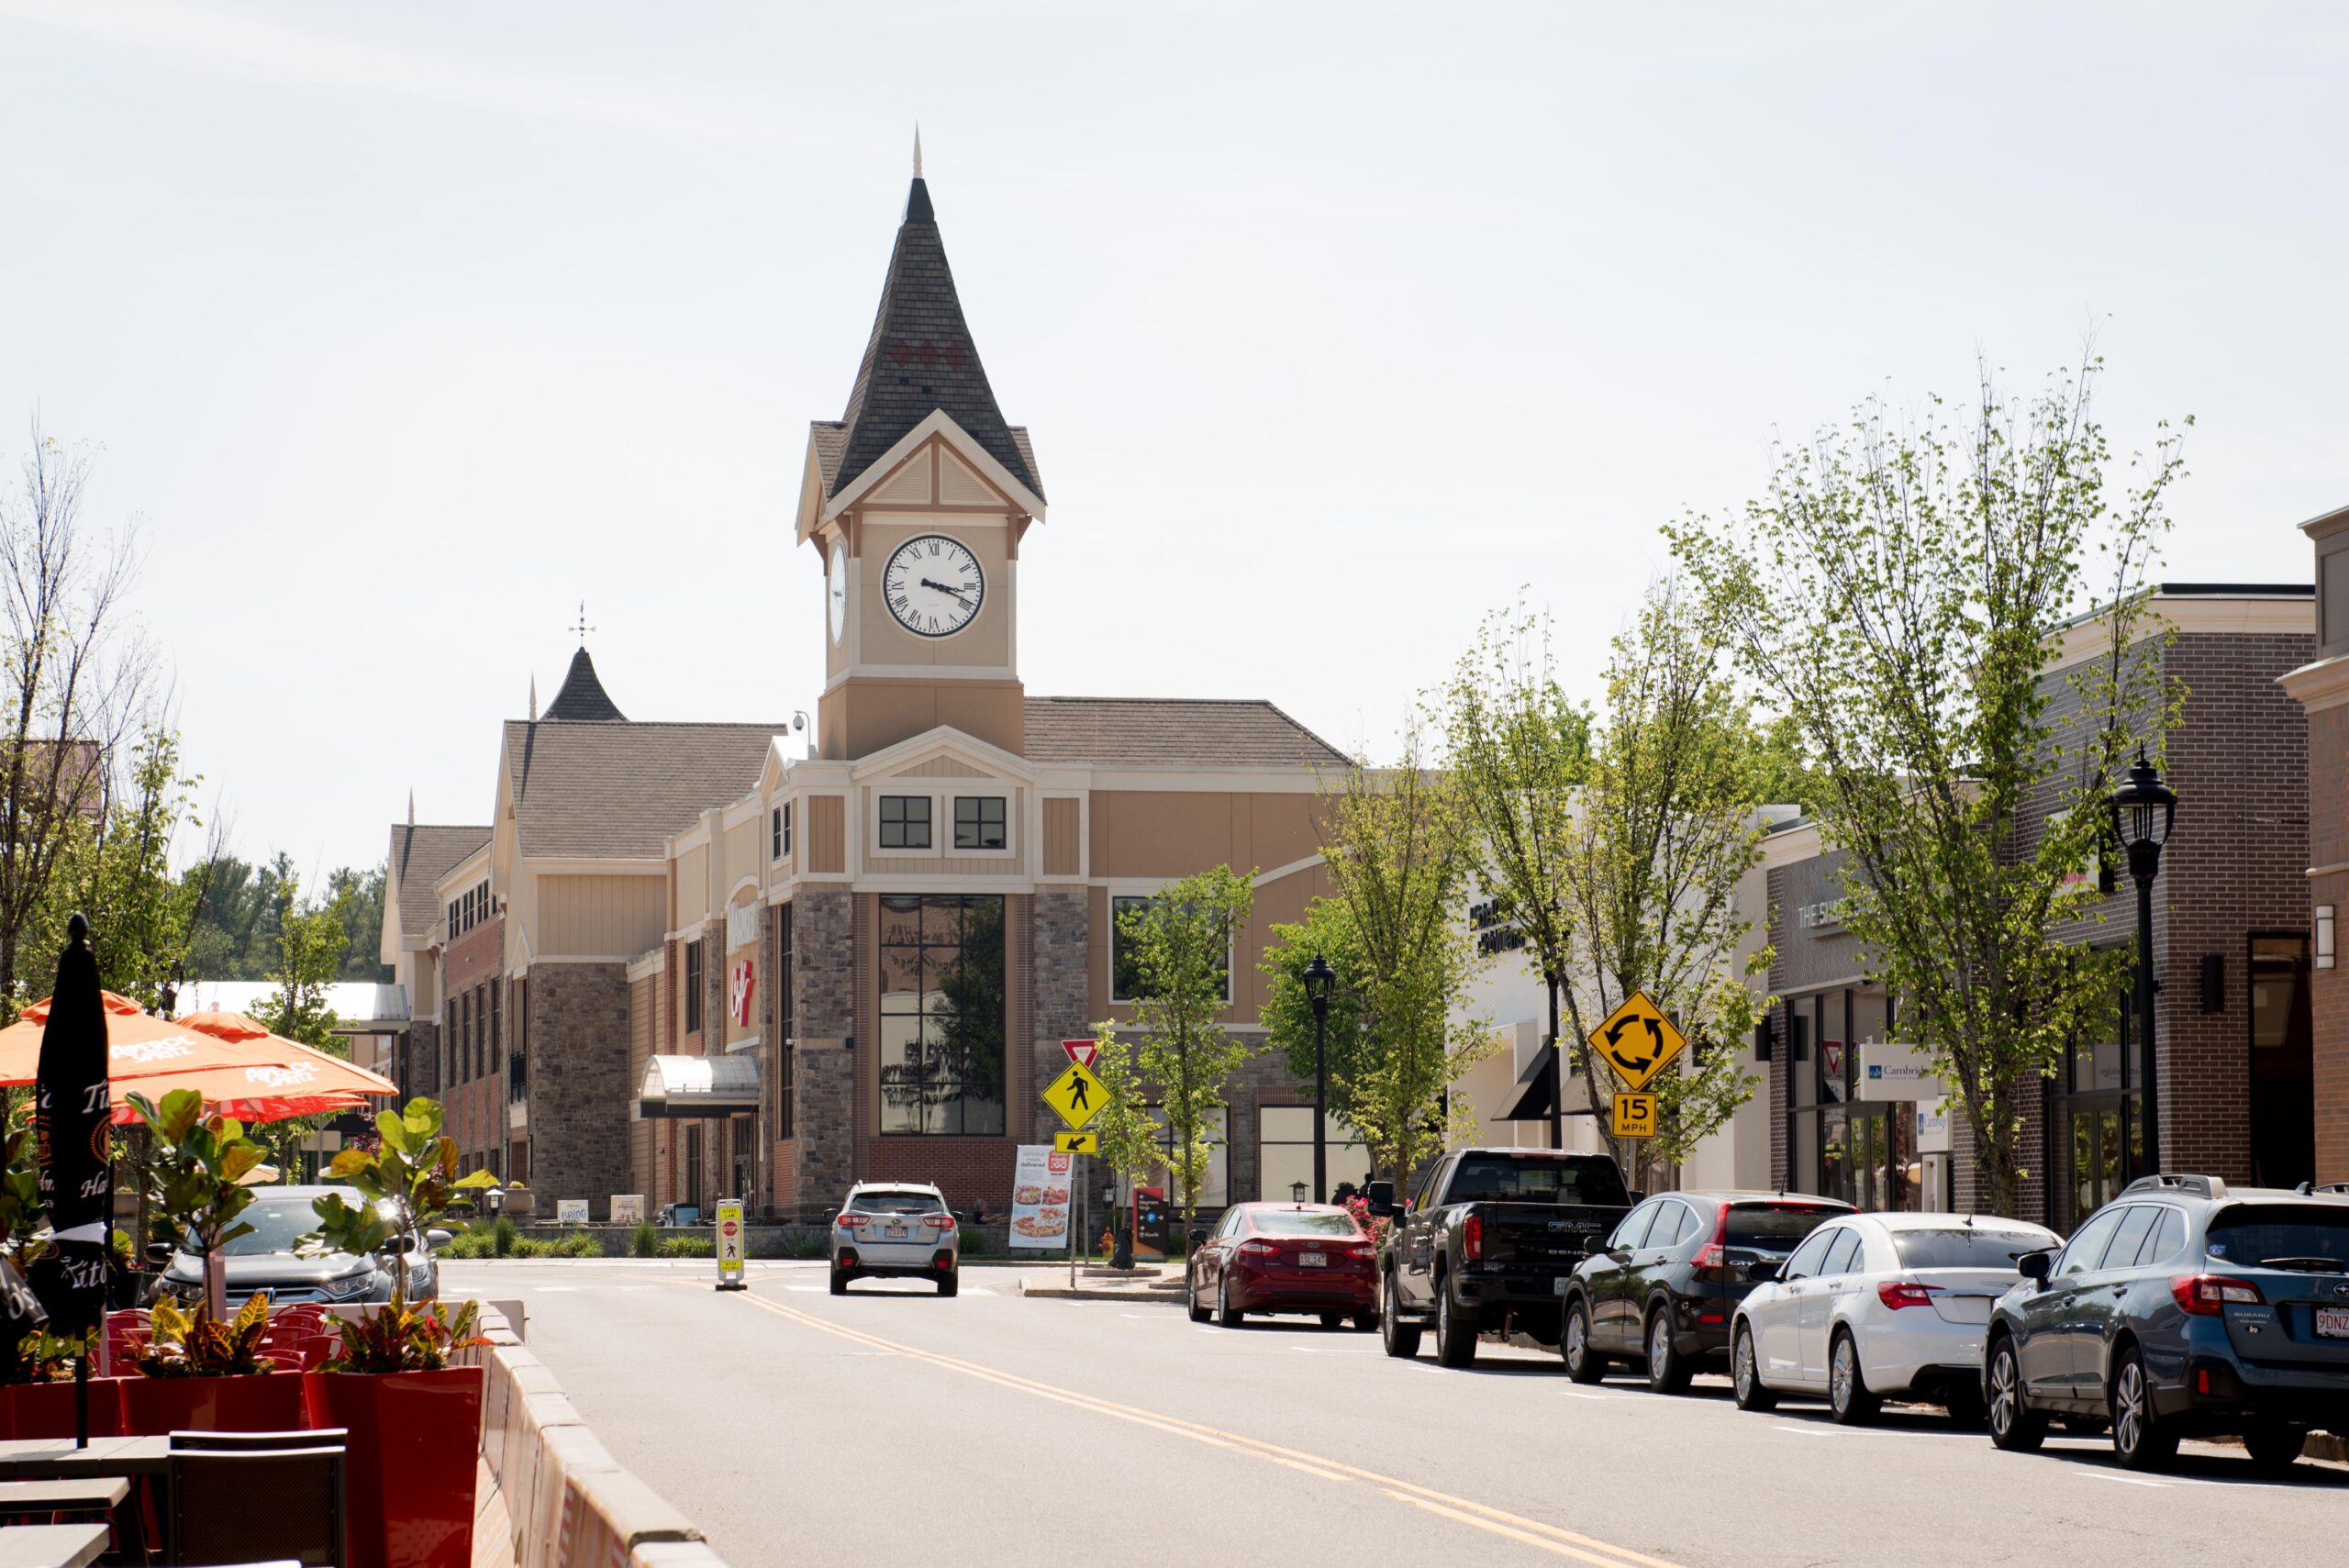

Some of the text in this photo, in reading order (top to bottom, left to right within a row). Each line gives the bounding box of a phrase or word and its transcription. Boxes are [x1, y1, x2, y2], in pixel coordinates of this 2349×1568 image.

[928, 542, 940, 556] XII
[1798, 904, 1818, 928] THE
[109, 1035, 196, 1059] APEROL
[135, 1046, 193, 1062] SPRITZ
[245, 1061, 320, 1083] APEROL
[267, 1072, 316, 1087] SPRITZ
[1621, 1098, 1648, 1120] 15
[1621, 1123, 1647, 1132] MPH
[561, 1209, 587, 1221] BRING
[1548, 1221, 1602, 1233] GMC
